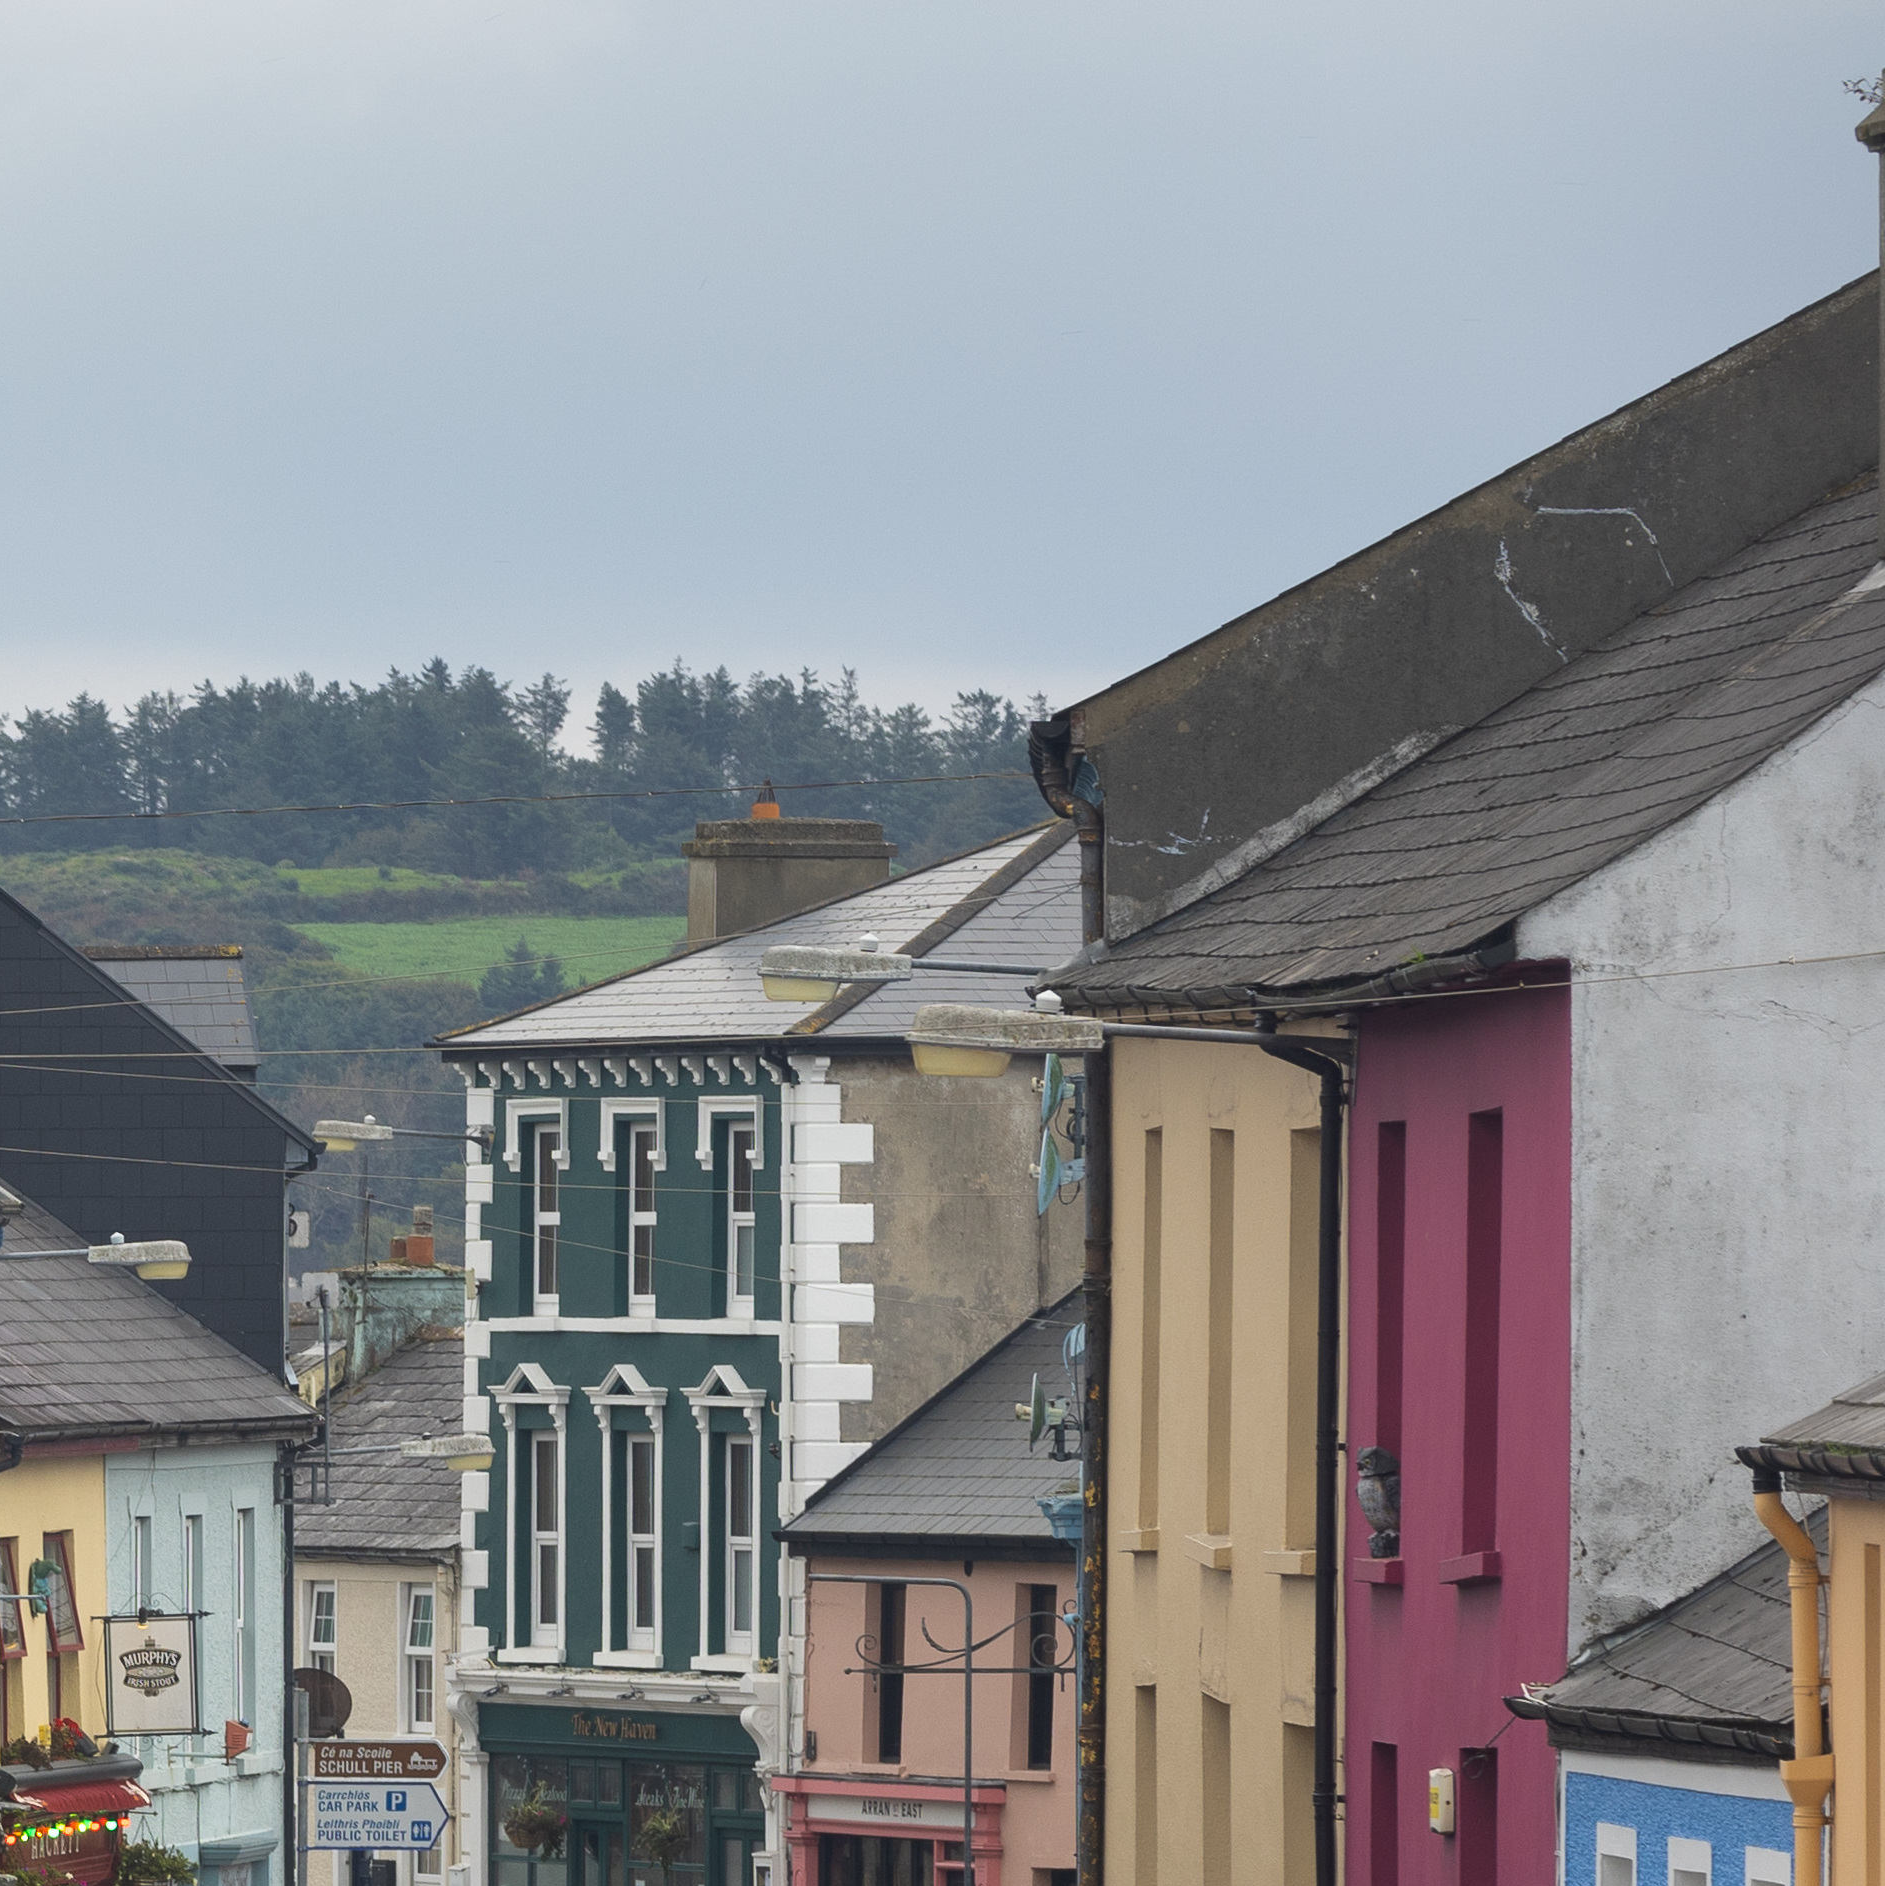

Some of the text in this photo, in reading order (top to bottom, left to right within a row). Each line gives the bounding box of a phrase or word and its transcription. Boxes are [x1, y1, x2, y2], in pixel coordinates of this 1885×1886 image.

[127, 1676, 176, 1688] IRISH STOUT
[572, 1712, 591, 1735] The
[594, 1716, 618, 1737] New
[321, 1747, 392, 1758] Cé na Scoile
[319, 1761, 403, 1774] SCHULL PIER
[318, 1801, 378, 1812] CAR PARK
[861, 1800, 890, 1816] ARRAN
[901, 1803, 923, 1818] EAST
[317, 1819, 358, 1829] Leithris
[318, 1831, 407, 1841] PUBLIC TOILET
